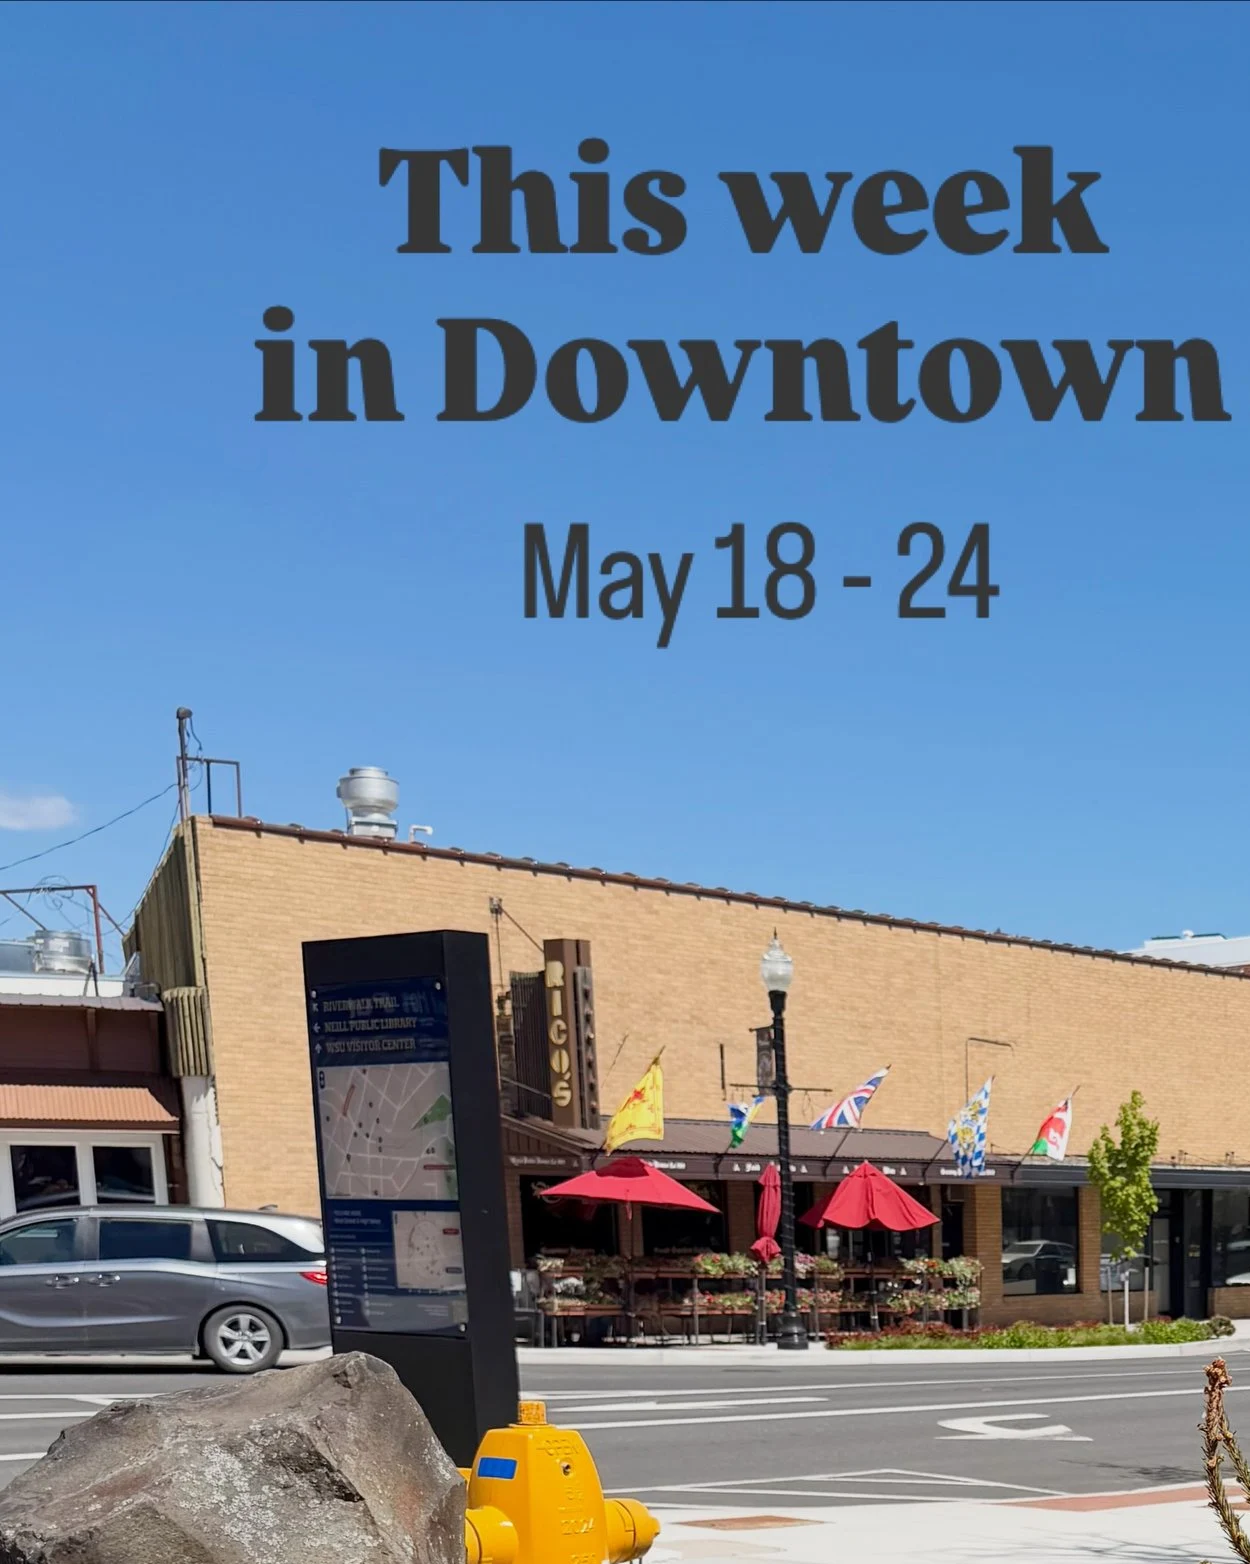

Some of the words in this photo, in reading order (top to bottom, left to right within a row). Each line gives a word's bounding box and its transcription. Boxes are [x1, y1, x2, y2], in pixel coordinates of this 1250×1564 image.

[374, 996, 400, 1008] TRAIL
[324, 1020, 349, 1033] NEILL
[350, 1018, 381, 1031] PUBLIC
[381, 1017, 417, 1030] LIBRARY
[546, 960, 572, 1107] RICO'S
[326, 1042, 346, 1054] WSU
[347, 1040, 381, 1052] VISITOR
[382, 1038, 416, 1050] CENTER
